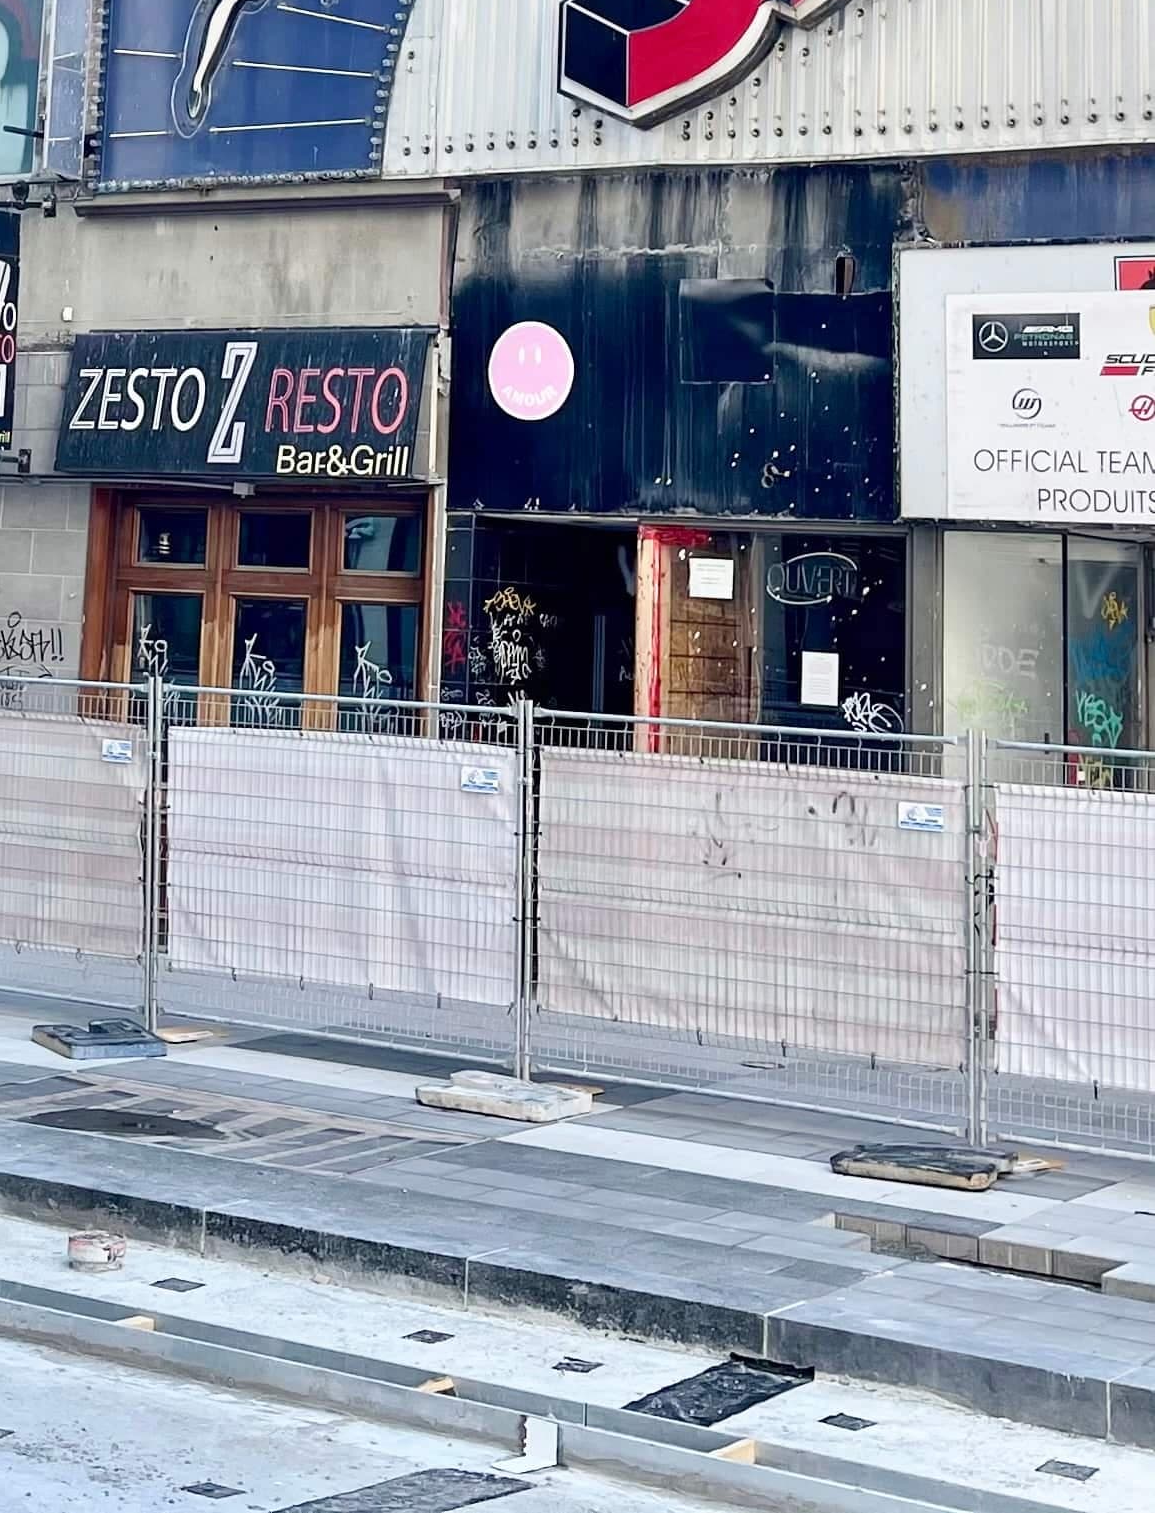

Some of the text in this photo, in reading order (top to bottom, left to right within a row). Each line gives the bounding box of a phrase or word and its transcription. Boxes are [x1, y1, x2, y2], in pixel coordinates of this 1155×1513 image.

[69, 368, 206, 432] ZESTO
[265, 367, 409, 435] RESTO
[501, 384, 558, 408] AMOUR
[973, 448, 1089, 474] OFFICIAL
